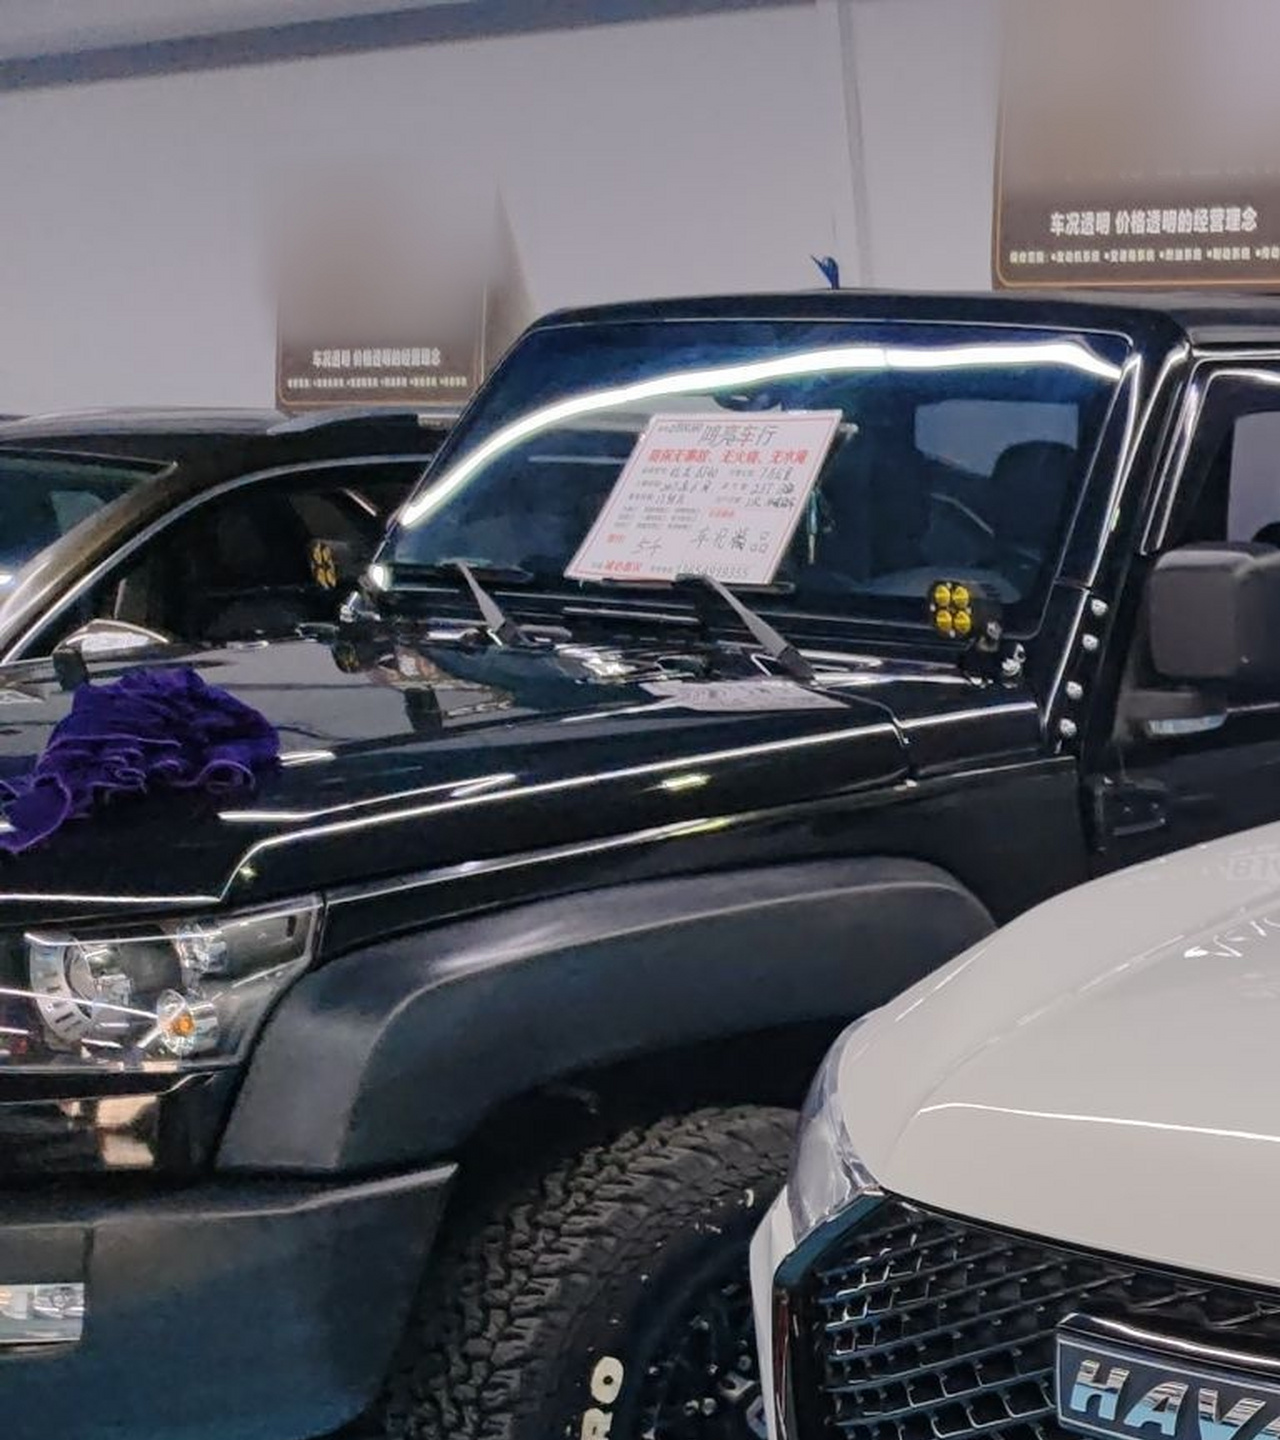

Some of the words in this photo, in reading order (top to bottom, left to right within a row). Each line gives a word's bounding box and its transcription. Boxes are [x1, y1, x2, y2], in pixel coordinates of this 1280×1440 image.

[1050, 211, 1110, 236] 车况透明
[1115, 206, 1258, 234] 价格透明的经营理念
